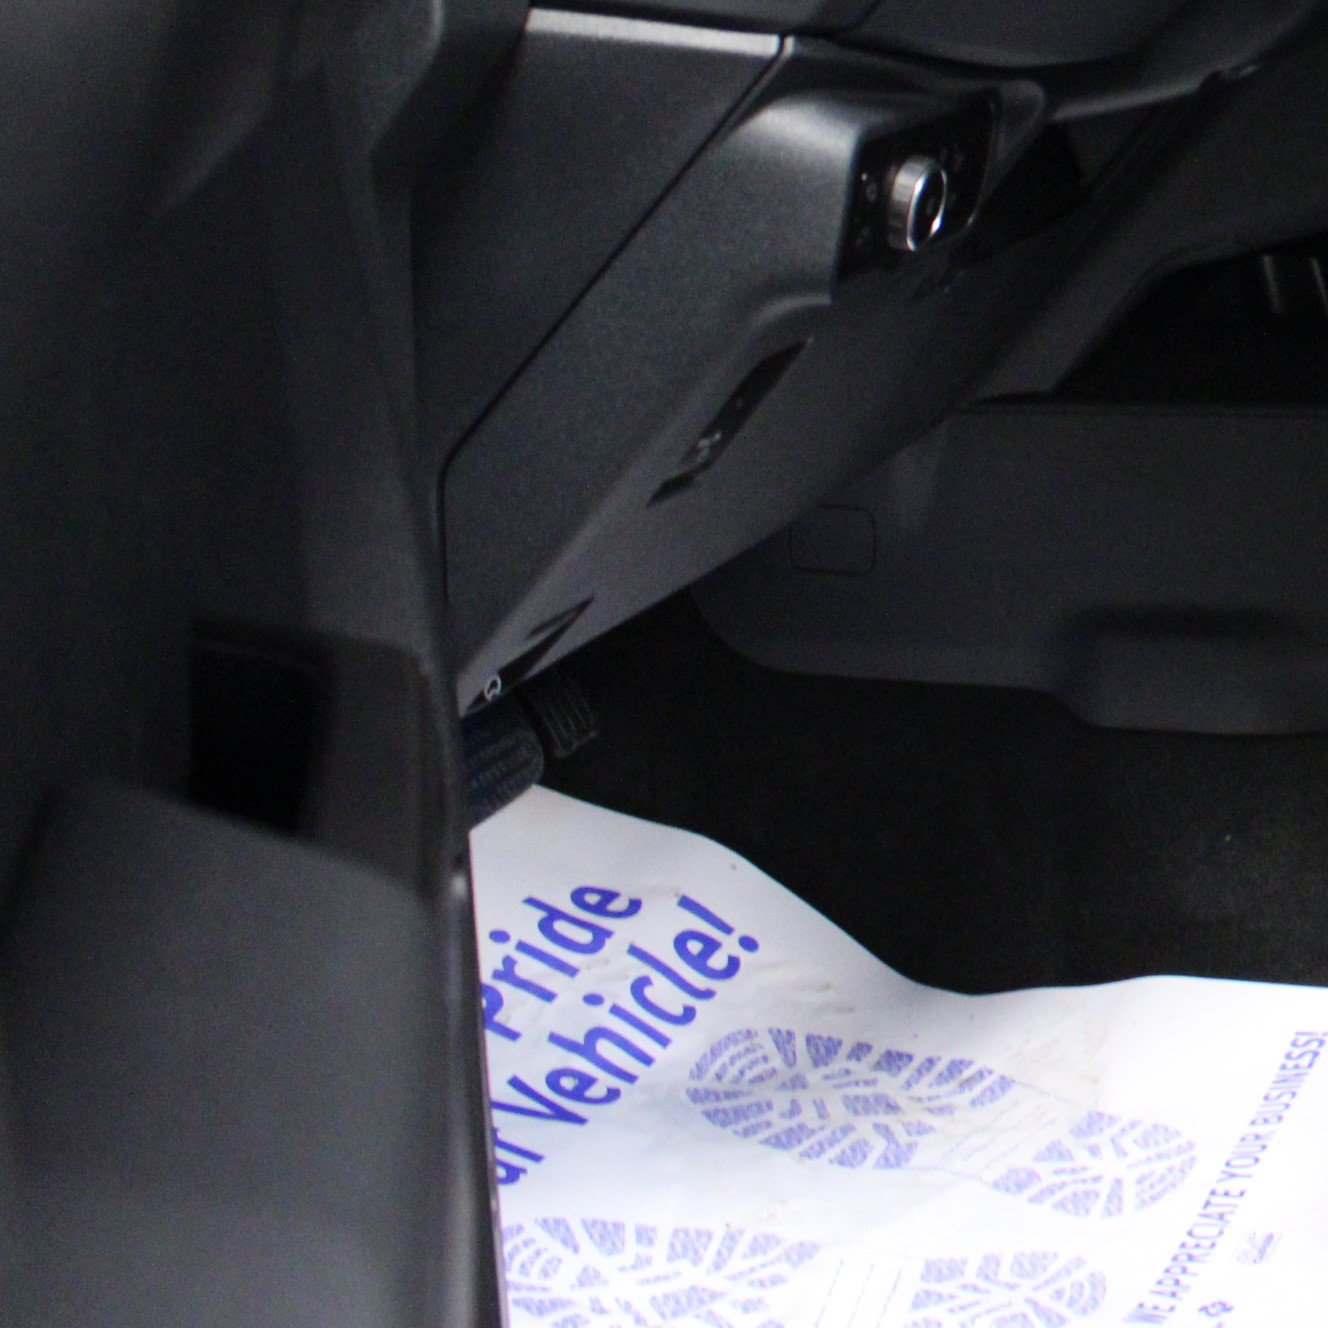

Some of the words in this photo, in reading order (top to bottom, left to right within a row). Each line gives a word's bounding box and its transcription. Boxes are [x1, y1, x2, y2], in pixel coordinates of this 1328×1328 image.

[480, 886, 642, 1041] Pride
[491, 895, 759, 1125] Vehicle!
[1149, 1189, 1246, 1301] APPRECIATE
[1216, 1132, 1274, 1184] YOUR
